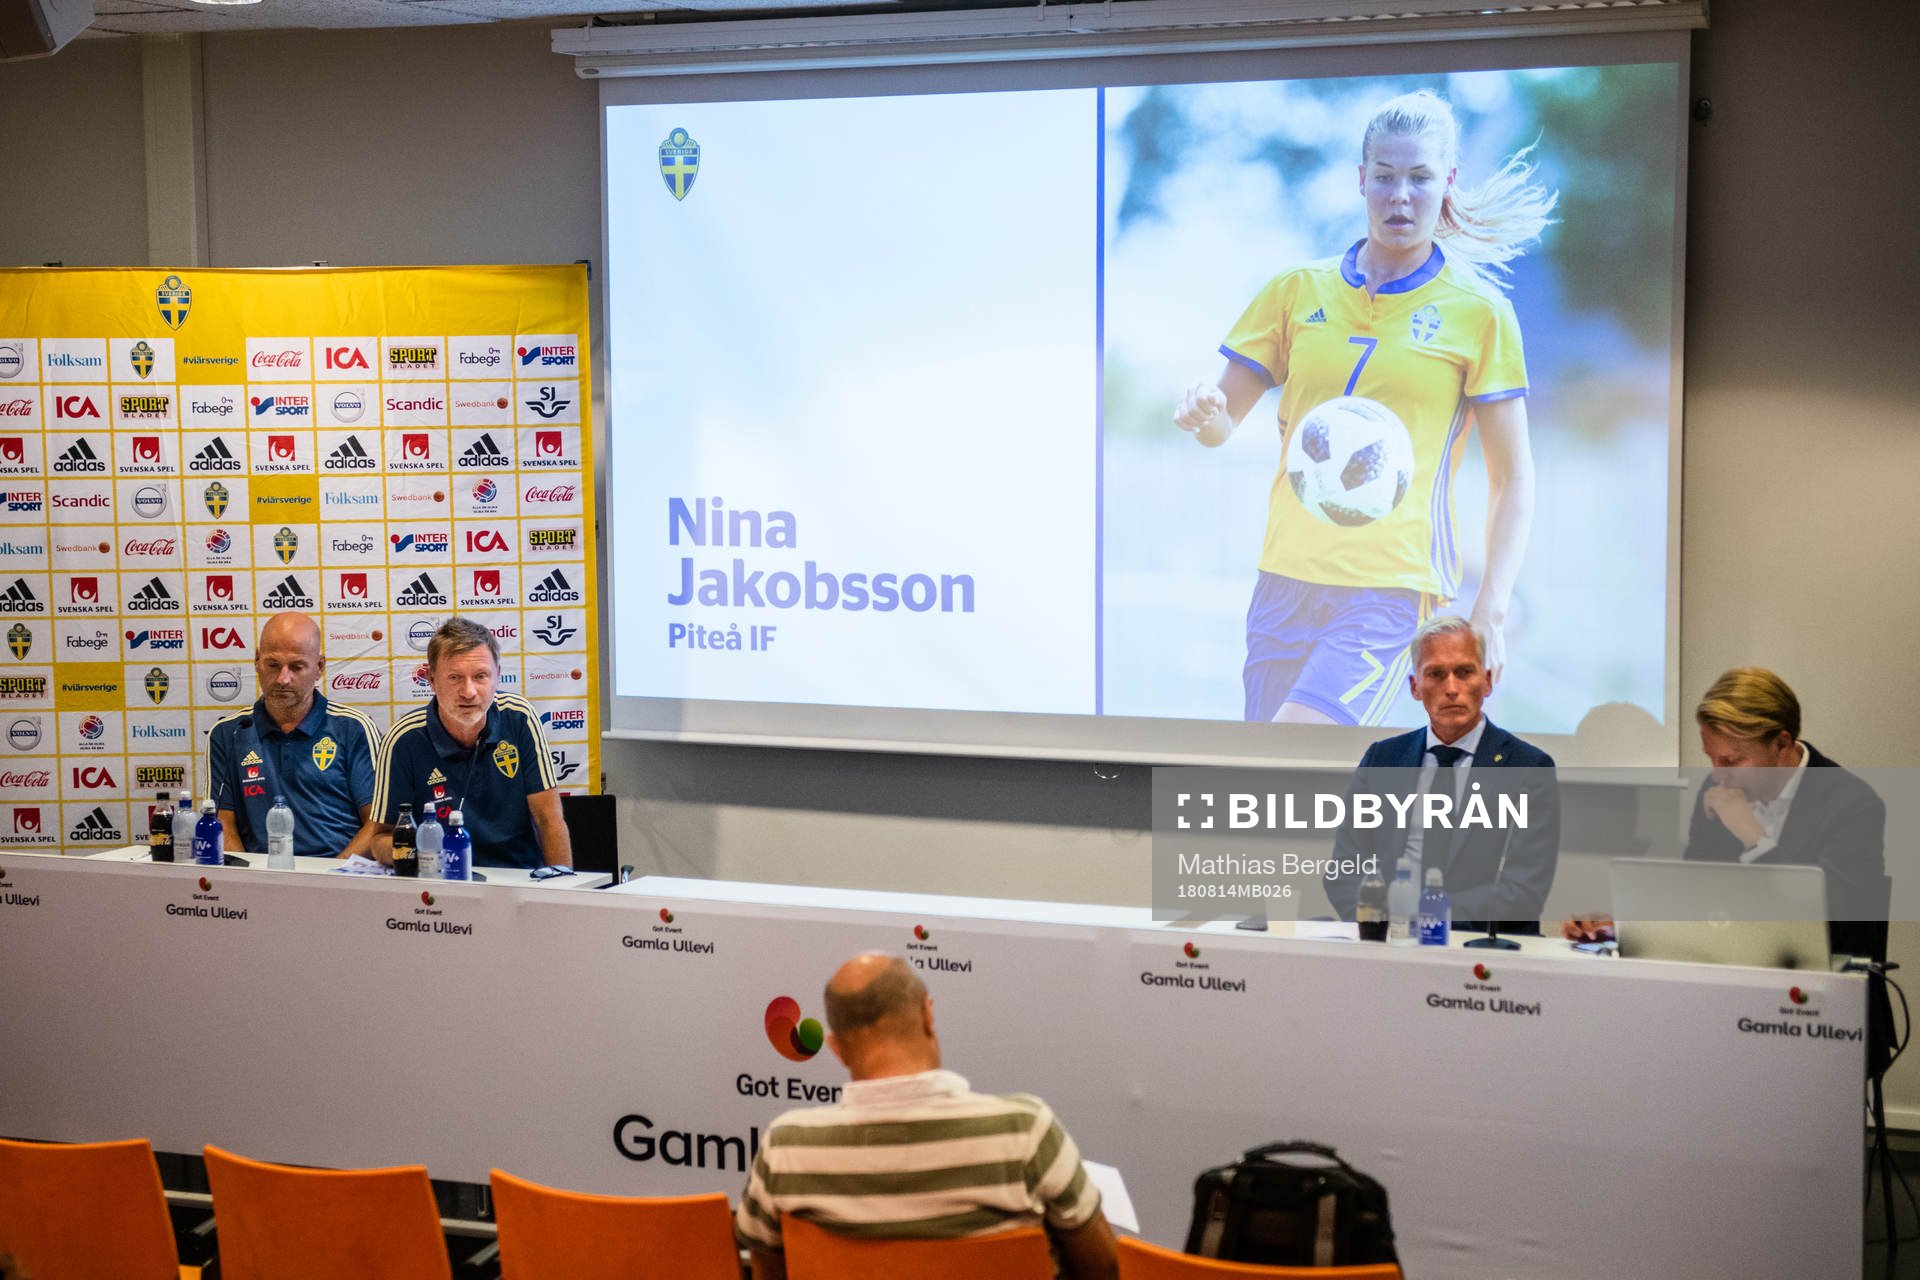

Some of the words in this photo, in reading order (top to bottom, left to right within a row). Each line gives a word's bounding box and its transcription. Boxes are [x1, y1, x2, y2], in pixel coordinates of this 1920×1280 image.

[326, 347, 369, 369] ICA
[389, 347, 437, 364] SPORT
[542, 346, 574, 356] INTER
[48, 353, 102, 367] Folksam
[183, 356, 239, 366] #viärsverige
[252, 350, 304, 368] Coca-Cola
[460, 352, 500, 366] Fabege
[542, 356, 575, 366] SPORT
[1344, 336, 1378, 397] 7
[275, 396, 308, 405] INTER
[540, 387, 556, 401] SJ
[56, 396, 100, 418] ICA
[121, 397, 169, 413] SPORT
[192, 402, 233, 416] Fabege
[276, 406, 309, 415] SPORT
[387, 398, 443, 410] Scandic
[54, 459, 105, 472] adidas
[190, 457, 241, 471] adidas
[324, 457, 375, 469] adidas
[458, 454, 509, 467] adidas
[8, 493, 41, 501] INTER
[256, 496, 312, 505] #viärsverige
[325, 492, 378, 505] Folksam
[391, 494, 432, 502] Swedbank
[525, 486, 577, 502] Coca-Cola
[8, 502, 42, 511] SPORT
[52, 495, 110, 508] Scandic
[669, 496, 797, 548] Nina
[415, 533, 448, 542] INTER
[466, 530, 510, 552] ICA
[529, 530, 577, 545] SPORT
[56, 544, 97, 552] Swedbank
[124, 538, 176, 556] Coca-Cola
[332, 539, 374, 553] Fabege
[415, 543, 448, 552] SPORT
[667, 557, 976, 613] Jakobsson
[262, 597, 314, 609] adidas
[396, 593, 447, 605] adidas
[529, 590, 579, 602] adidas
[128, 599, 179, 611] adidas
[547, 615, 562, 629] SJ
[150, 630, 183, 639] INTER
[202, 628, 246, 649] ICA
[329, 633, 370, 641] Swedbank
[668, 622, 742, 650] Piteå
[750, 626, 777, 651] IF
[66, 636, 108, 650] Fabege
[150, 640, 184, 649] SPORT
[0, 678, 46, 693] SPORT
[62, 682, 117, 692] #viärsverige
[332, 673, 382, 690] Coca-Cola
[552, 711, 583, 720] INTER
[132, 725, 186, 738] Folksam
[552, 720, 585, 730] SPORT
[0, 771, 51, 788] Coca-Cola
[73, 767, 117, 788] ICA
[137, 767, 184, 782] SPORT
[244, 785, 266, 797] ICA
[70, 829, 121, 841] adidas
[5, 893, 40, 906] Ullevi
[166, 904, 208, 917] Gamla
[211, 906, 248, 920] Ullevi
[386, 918, 430, 934] Gamla
[434, 921, 472, 936] Ullevi
[622, 936, 669, 951] Gamla
[673, 939, 714, 954] Ullevi
[928, 957, 972, 973] Ullevi
[1141, 972, 1195, 989] Gamla
[1199, 975, 1246, 993] Ullevi
[1426, 993, 1485, 1012] Gamla
[1489, 997, 1541, 1017] Ullevi
[1737, 1017, 1802, 1038] Gamla
[1807, 1022, 1863, 1042] Ullevi
[736, 1073, 779, 1098] Got
[613, 1114, 759, 1172] Gaml
